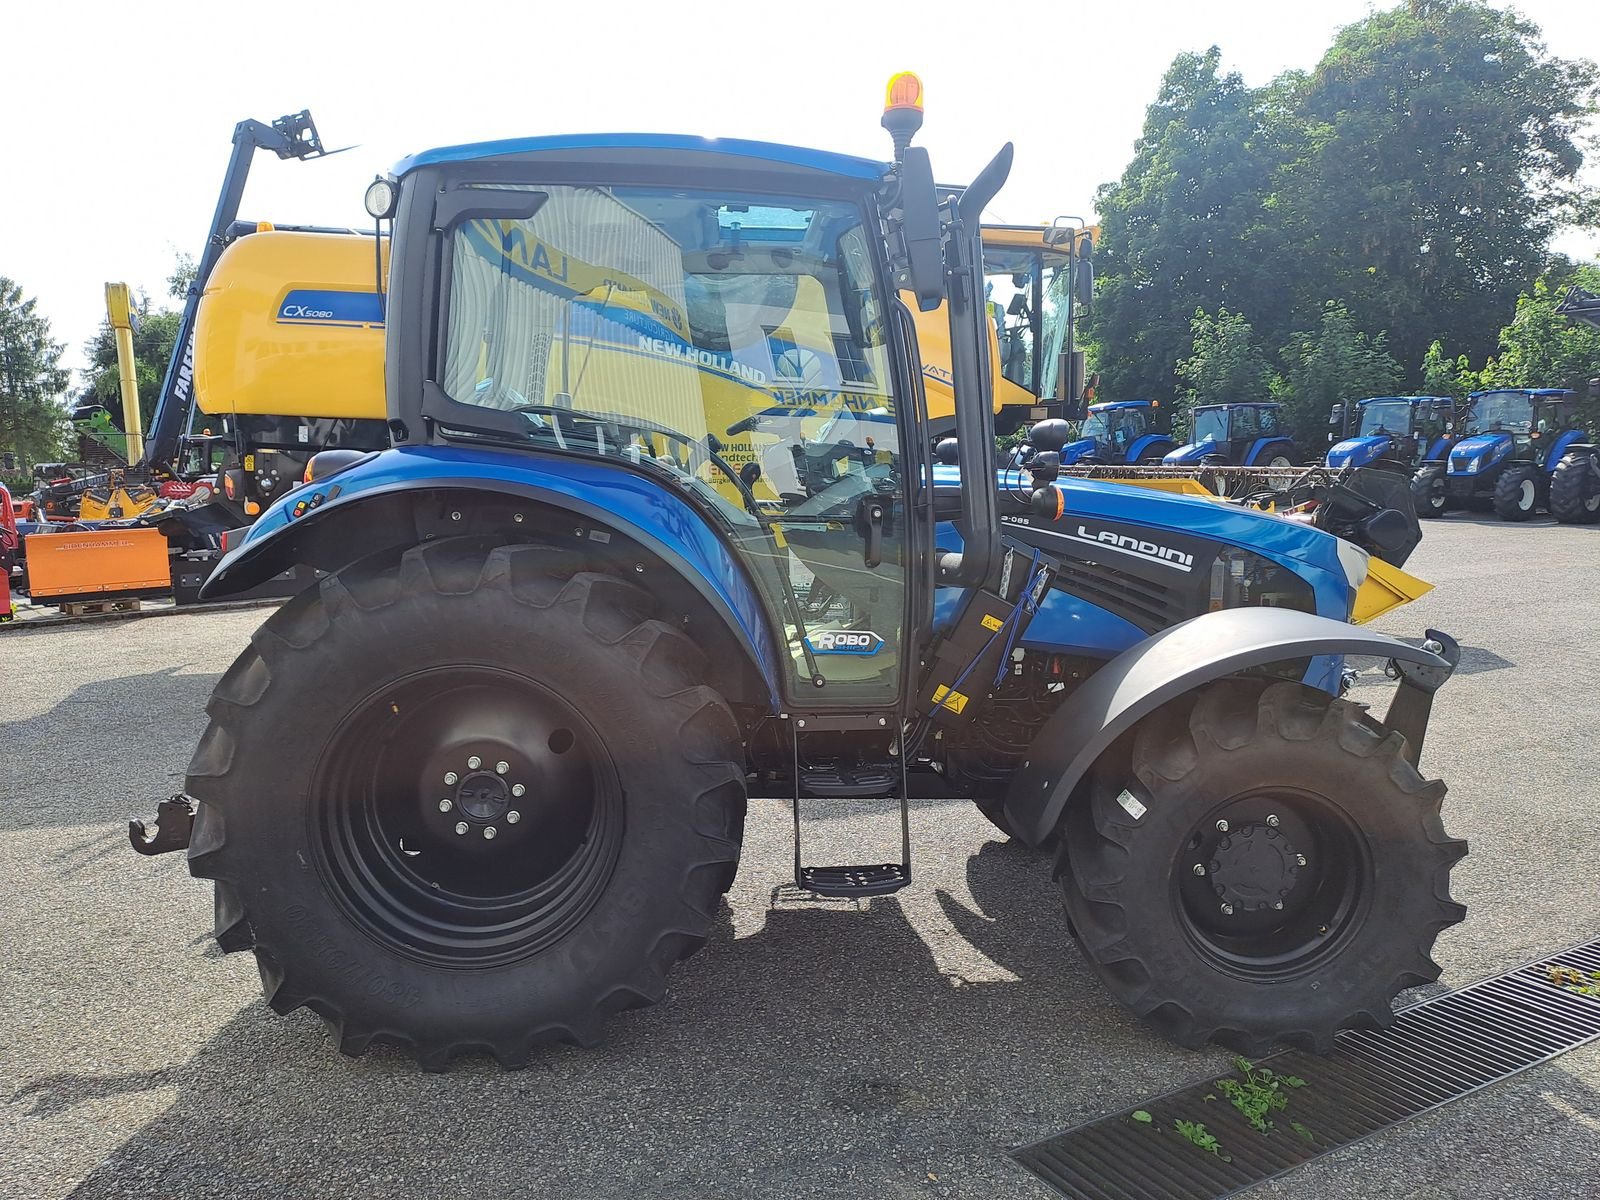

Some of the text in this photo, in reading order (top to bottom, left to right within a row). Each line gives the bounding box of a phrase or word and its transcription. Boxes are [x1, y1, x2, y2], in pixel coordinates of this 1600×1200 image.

[283, 305, 333, 318] CX5080
[639, 335, 766, 385] NEW HOLLAND
[1077, 525, 1194, 565] LANDINI
[818, 633, 870, 649] ROBO
